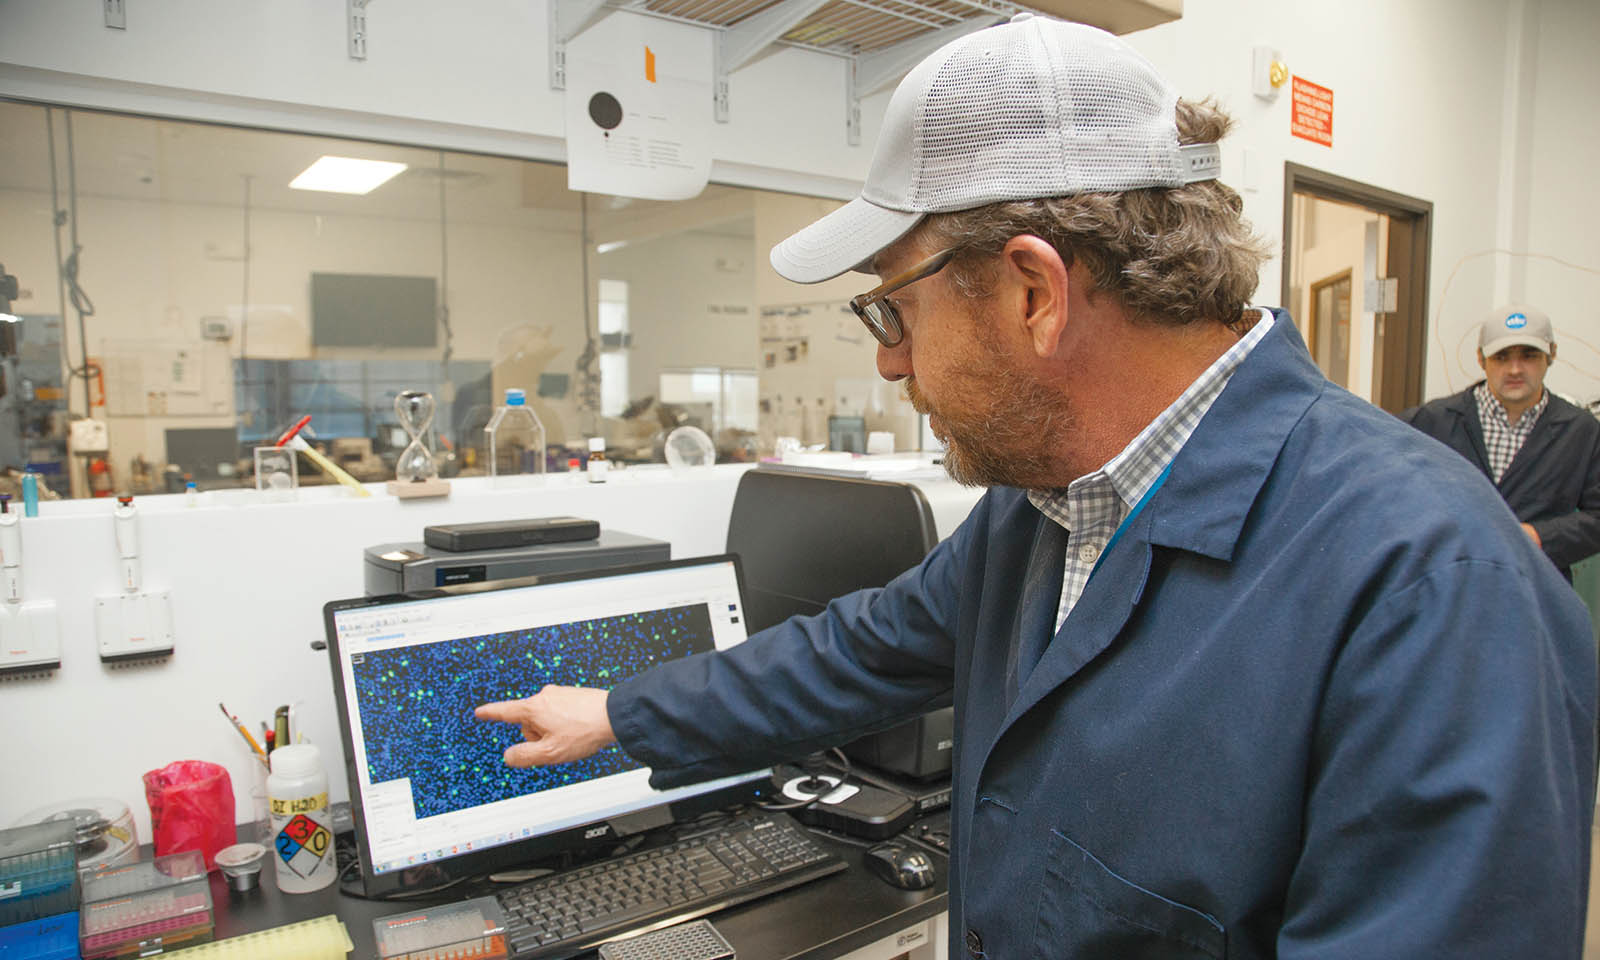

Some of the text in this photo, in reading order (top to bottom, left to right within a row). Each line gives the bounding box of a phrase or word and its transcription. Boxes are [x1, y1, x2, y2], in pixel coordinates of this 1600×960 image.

[293, 819, 309, 840] 3
[584, 825, 610, 839] acer
[279, 831, 327, 855] 2 0
